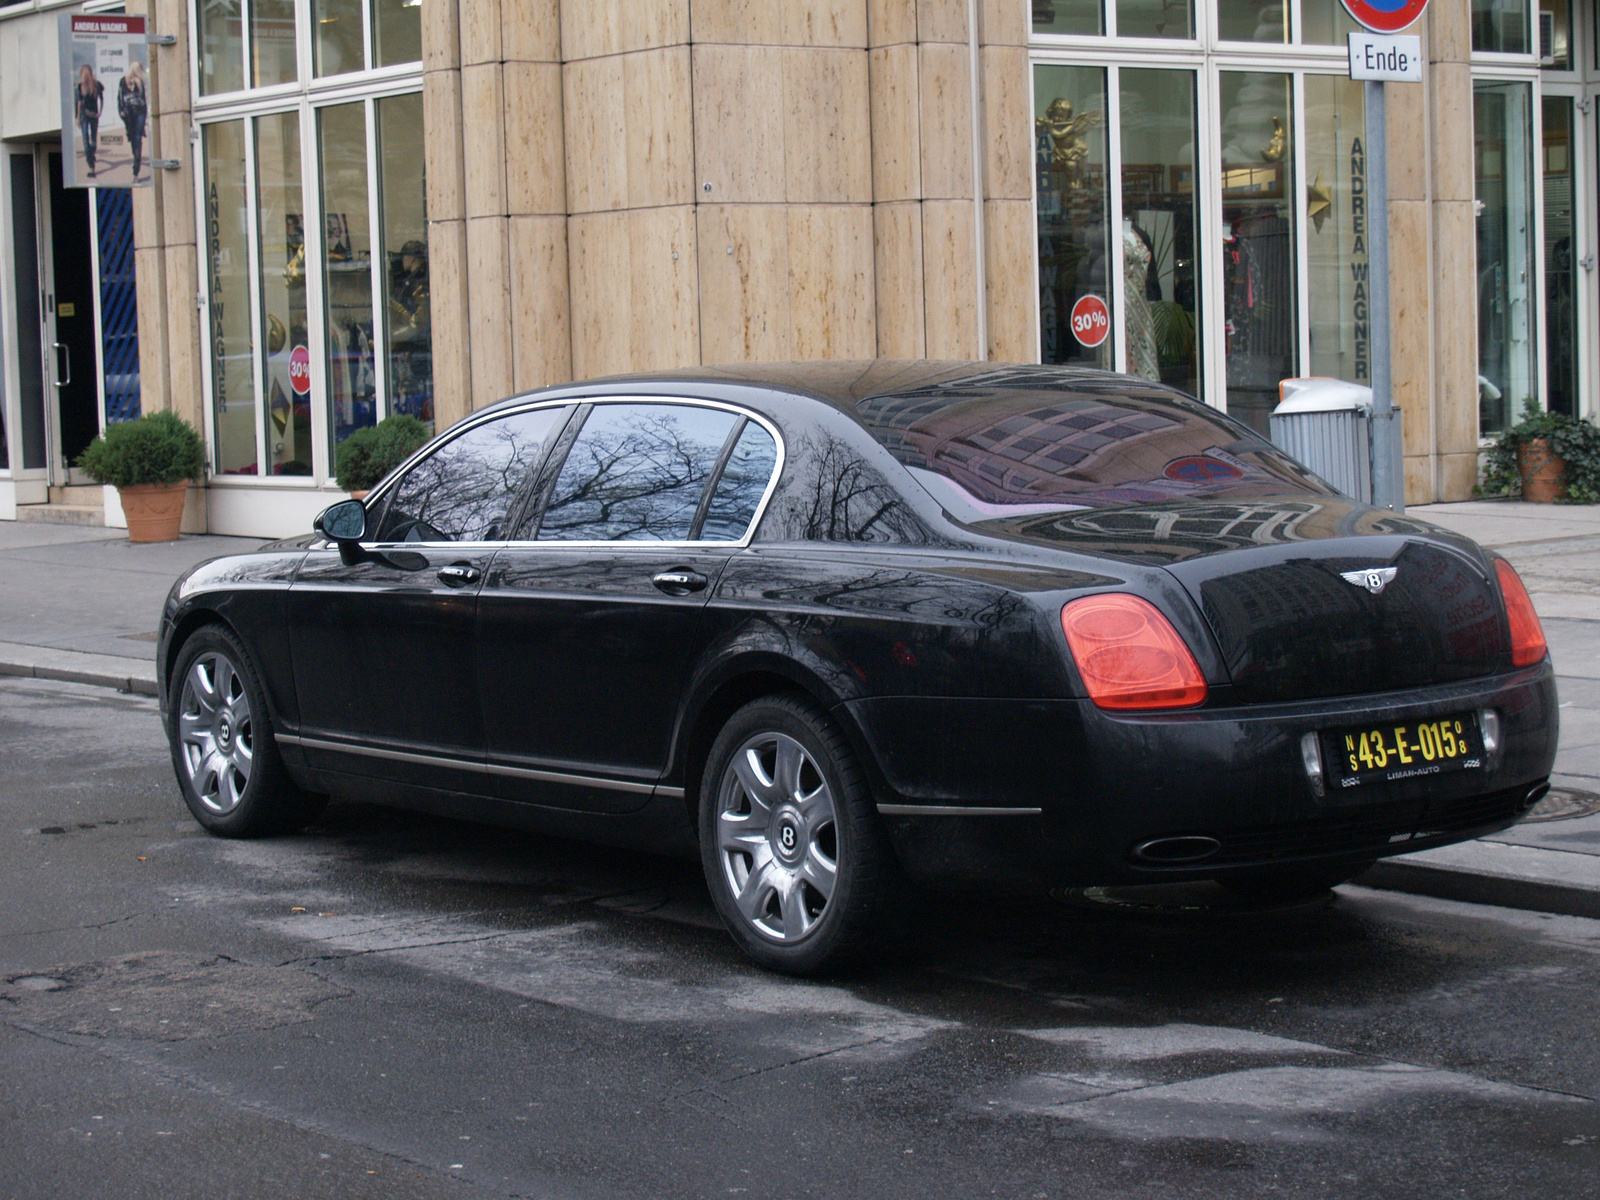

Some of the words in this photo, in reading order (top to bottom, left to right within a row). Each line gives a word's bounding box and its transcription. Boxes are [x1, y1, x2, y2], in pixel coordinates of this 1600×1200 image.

[74, 21, 99, 31] ANDREA
[100, 22, 128, 32] WAGNER
[1365, 44, 1408, 71] Ende
[1351, 137, 1365, 254] ANDREA
[210, 182, 222, 293] ANDREA
[1040, 266, 1057, 364] WAGNE
[1074, 311, 1106, 332] 30%
[1351, 263, 1368, 379] WAGNER
[213, 302, 227, 413] WAGNER
[291, 361, 310, 379] 30%
[1367, 573, 1381, 588] B
[1387, 765, 1440, 780] LIMAN-AUTO
[782, 826, 794, 847] B
